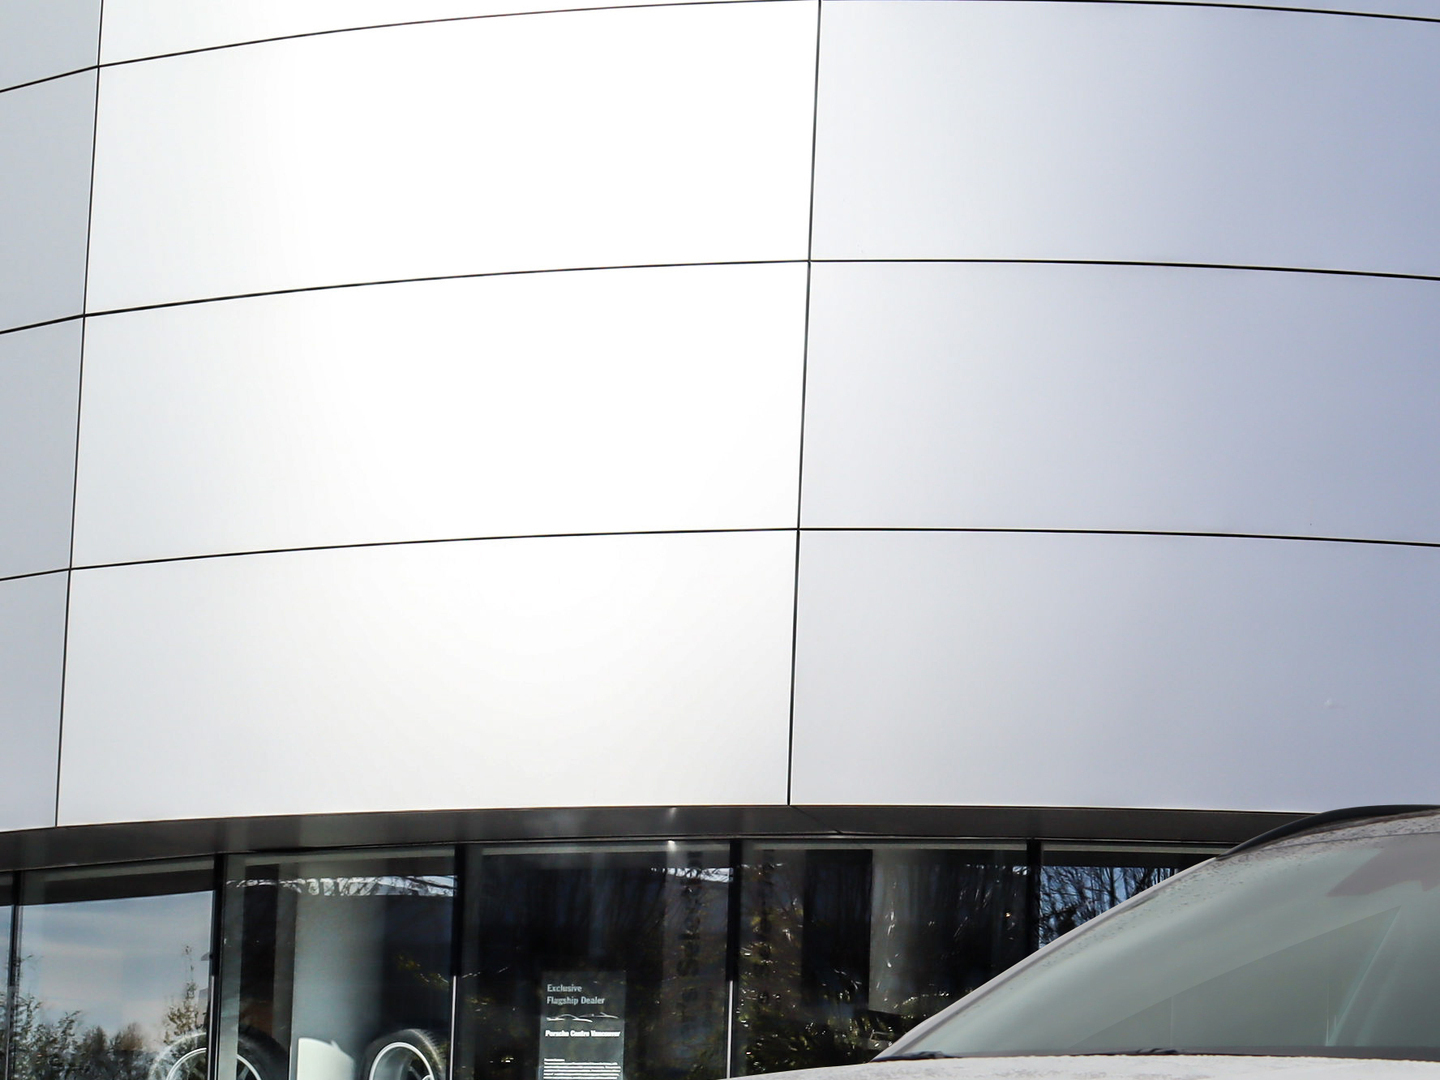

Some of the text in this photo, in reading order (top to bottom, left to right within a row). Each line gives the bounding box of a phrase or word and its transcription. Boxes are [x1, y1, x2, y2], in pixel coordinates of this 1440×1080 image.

[546, 983, 583, 993] Exclusive
[546, 996, 606, 1006] Flagship Dealer
